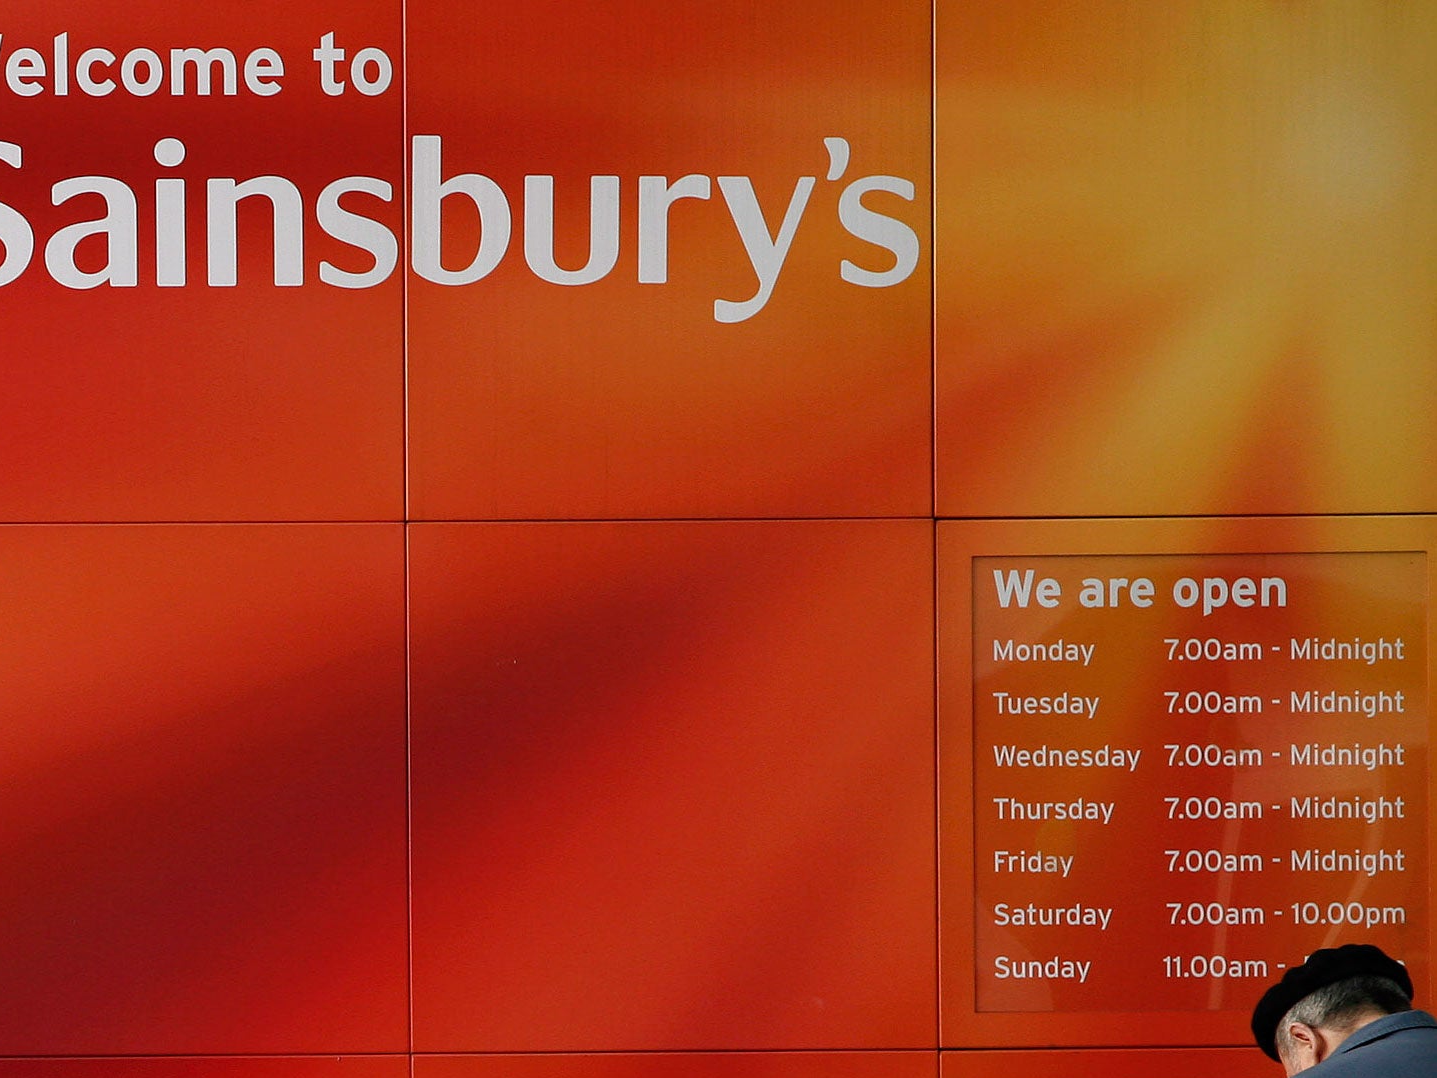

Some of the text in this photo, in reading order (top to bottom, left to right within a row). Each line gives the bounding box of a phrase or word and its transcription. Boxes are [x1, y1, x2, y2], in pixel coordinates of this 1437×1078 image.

[313, 32, 392, 96] to
[994, 570, 1286, 616] We are open
[994, 640, 1094, 665] Monday
[1164, 639, 1261, 660] 7.00am
[1291, 638, 1404, 664] Midnight
[993, 693, 1099, 718] Tuesday
[1164, 692, 1261, 713] 7.00am
[1291, 691, 1404, 717] Midnight
[994, 745, 1140, 771] Wednesday
[1164, 745, 1261, 766] 7.00am
[1291, 744, 1404, 770] Midnight
[994, 798, 1114, 824] Thursday
[1165, 797, 1261, 819] 7.00am
[1292, 797, 1404, 823] Midnight
[995, 851, 1073, 877] Friday
[1165, 850, 1262, 872] 7.00am
[1292, 850, 1404, 876] Midnight
[995, 904, 1112, 930] Saturday
[1167, 903, 1263, 924] 7.00am
[1292, 903, 1404, 928] 10.00pm
[995, 957, 1090, 982] Sunday
[1163, 956, 1266, 977] 11.00am
